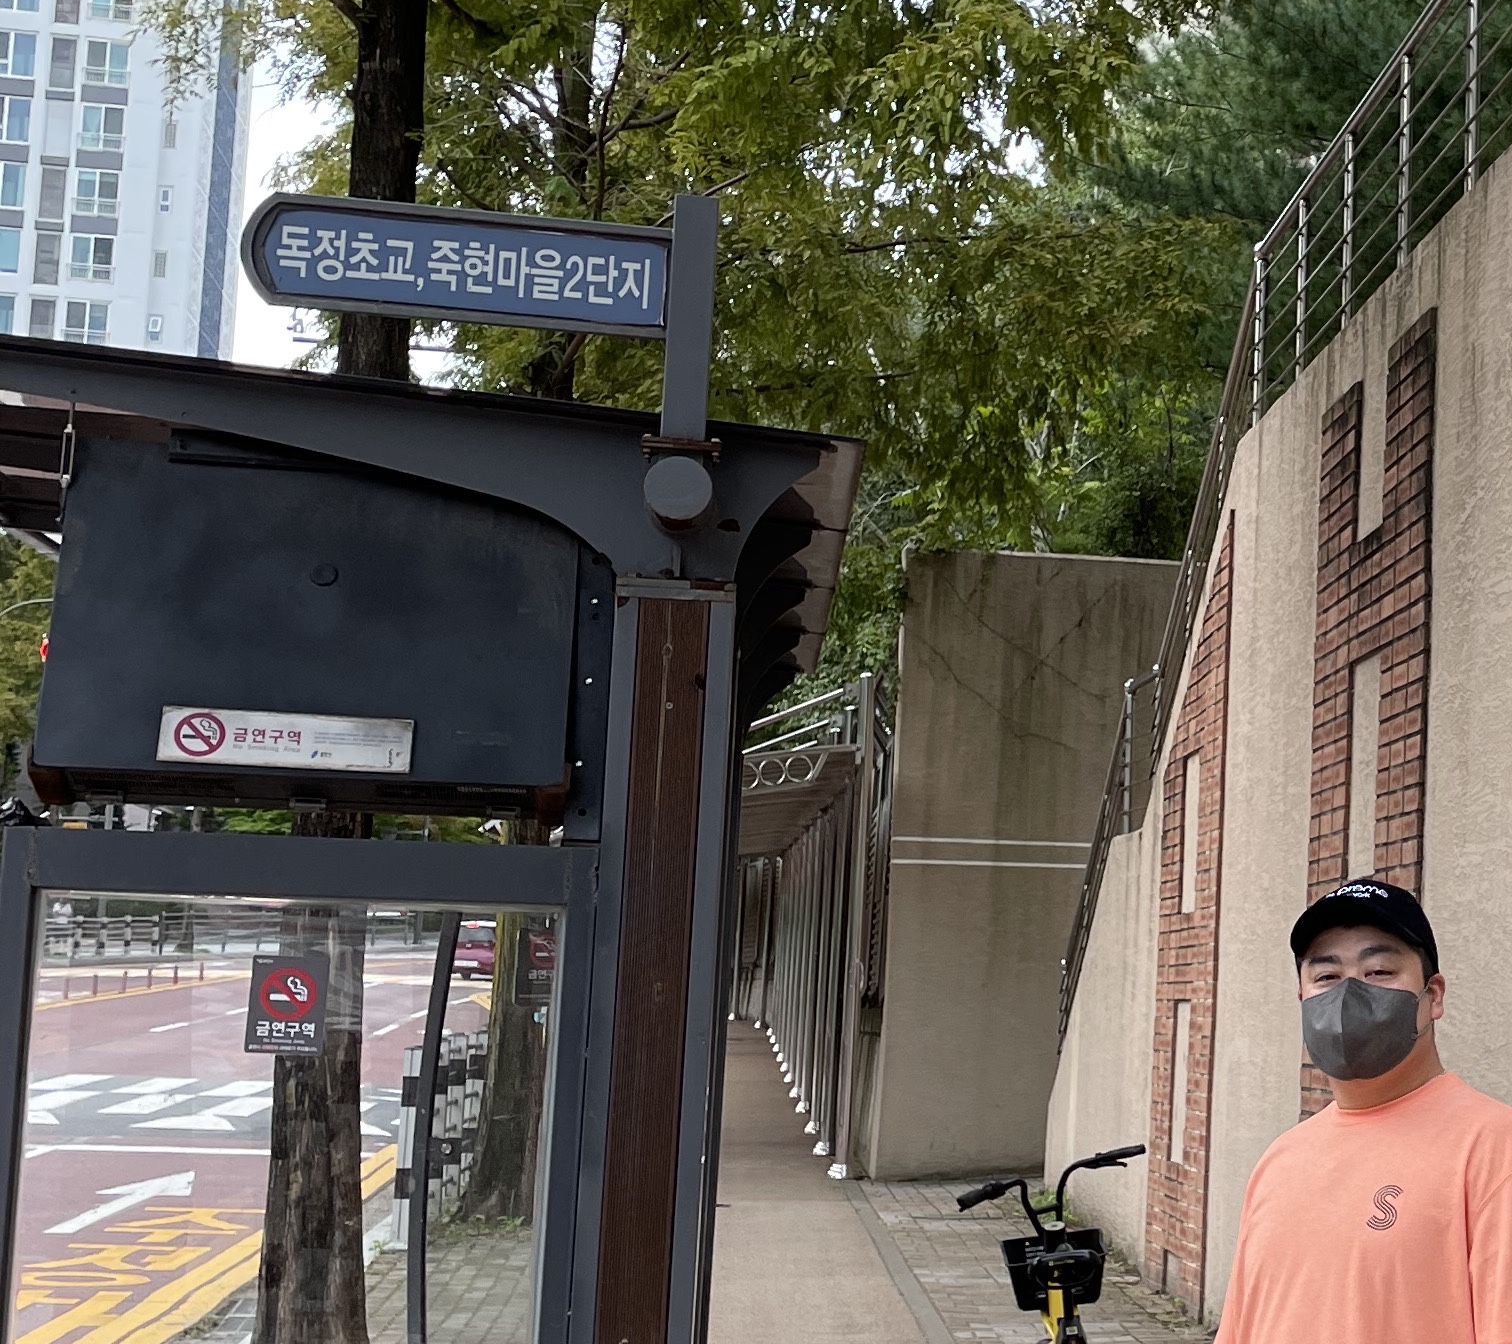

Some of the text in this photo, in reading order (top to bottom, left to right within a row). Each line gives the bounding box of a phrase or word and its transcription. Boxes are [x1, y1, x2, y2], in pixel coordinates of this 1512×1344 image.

[233, 727, 302, 746] 금연구역
[256, 1020, 316, 1039] 금연구역
[1366, 1184, 1404, 1231] S
